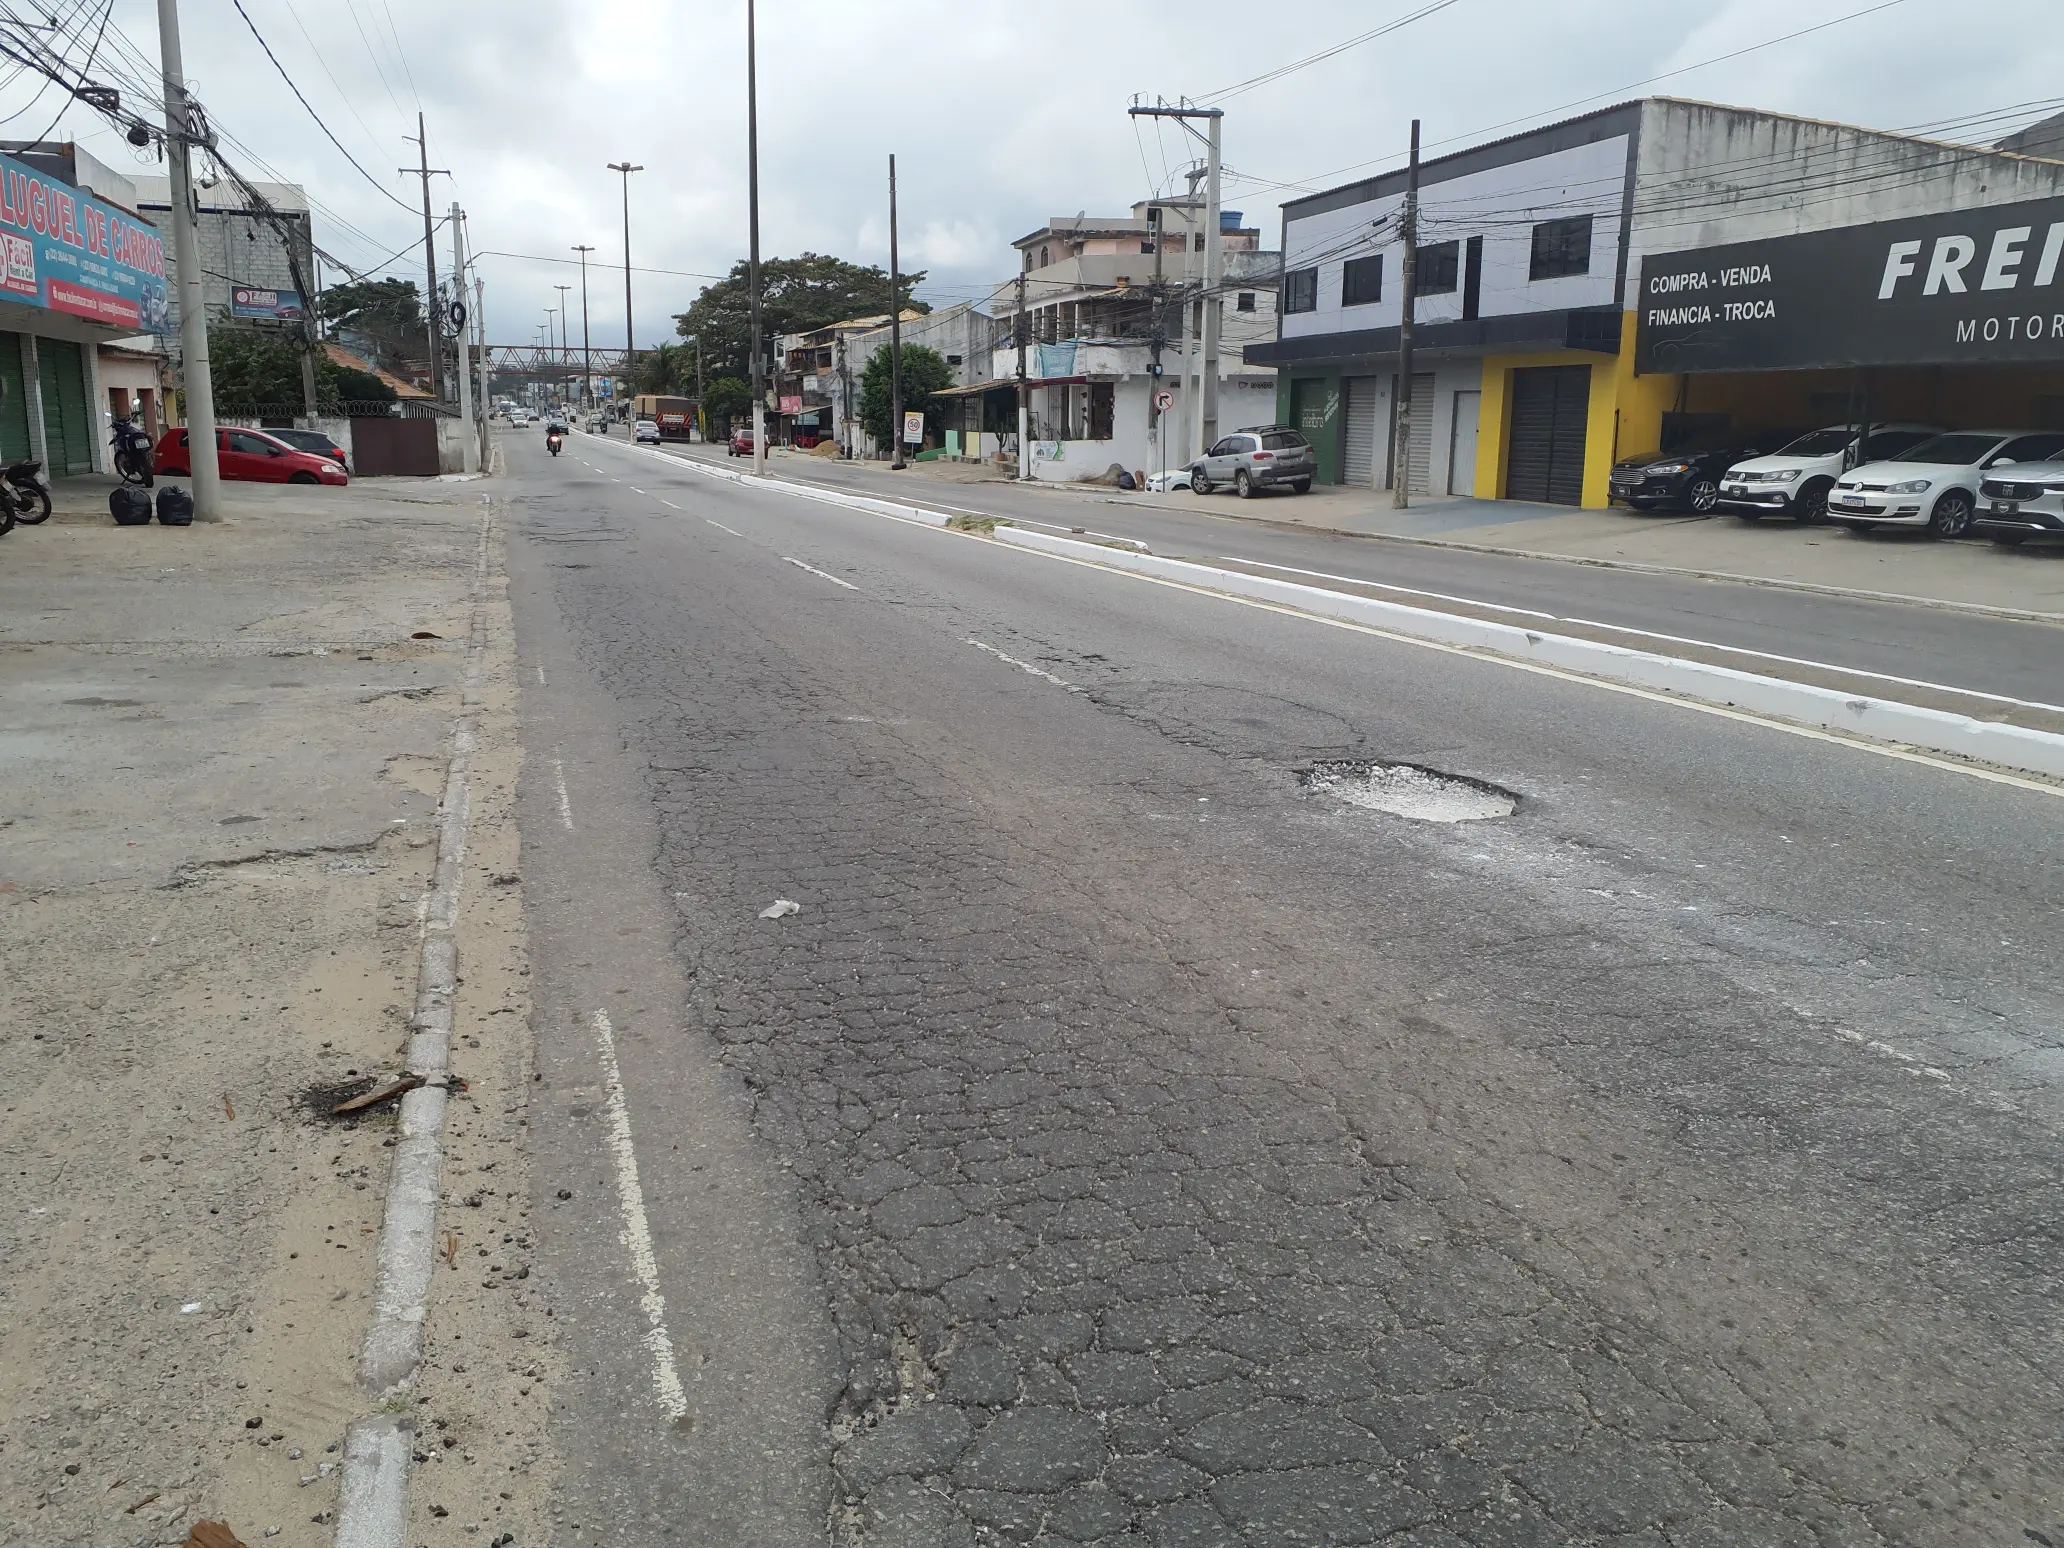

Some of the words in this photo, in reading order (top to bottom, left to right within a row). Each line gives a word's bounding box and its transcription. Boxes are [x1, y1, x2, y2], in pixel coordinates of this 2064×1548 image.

[7, 239, 33, 268] Fácil
[84, 204, 109, 260] DE
[111, 217, 165, 279] CARROS
[1878, 222, 2064, 299] FREI
[1650, 271, 1708, 294] COMPRA
[1720, 264, 1772, 287] VENDA
[1648, 305, 1711, 326] FINANCIA
[1723, 299, 1776, 321] TROCA
